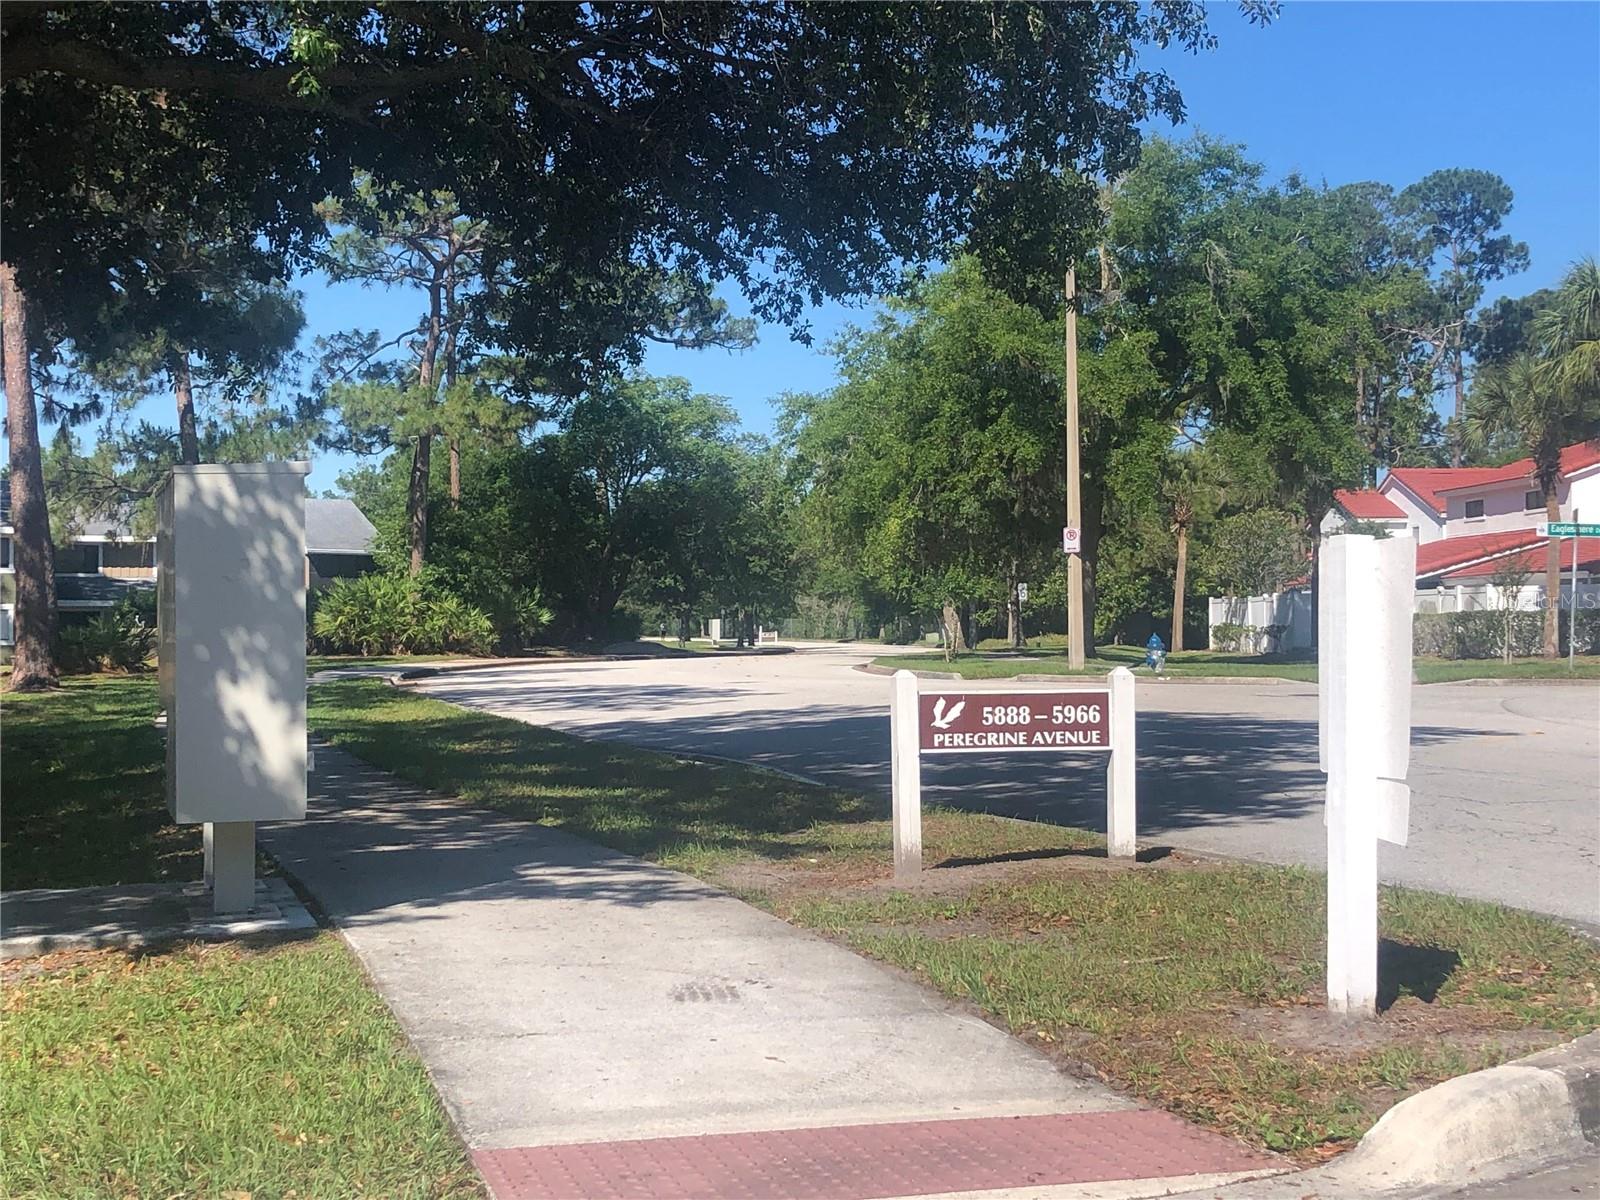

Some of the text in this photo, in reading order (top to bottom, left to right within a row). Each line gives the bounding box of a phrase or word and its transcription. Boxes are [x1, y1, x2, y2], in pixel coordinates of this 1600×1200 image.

[981, 705, 1031, 726] 5888
[1052, 704, 1101, 725] 5966
[933, 730, 1101, 747] PEREGRINE AVENUE
